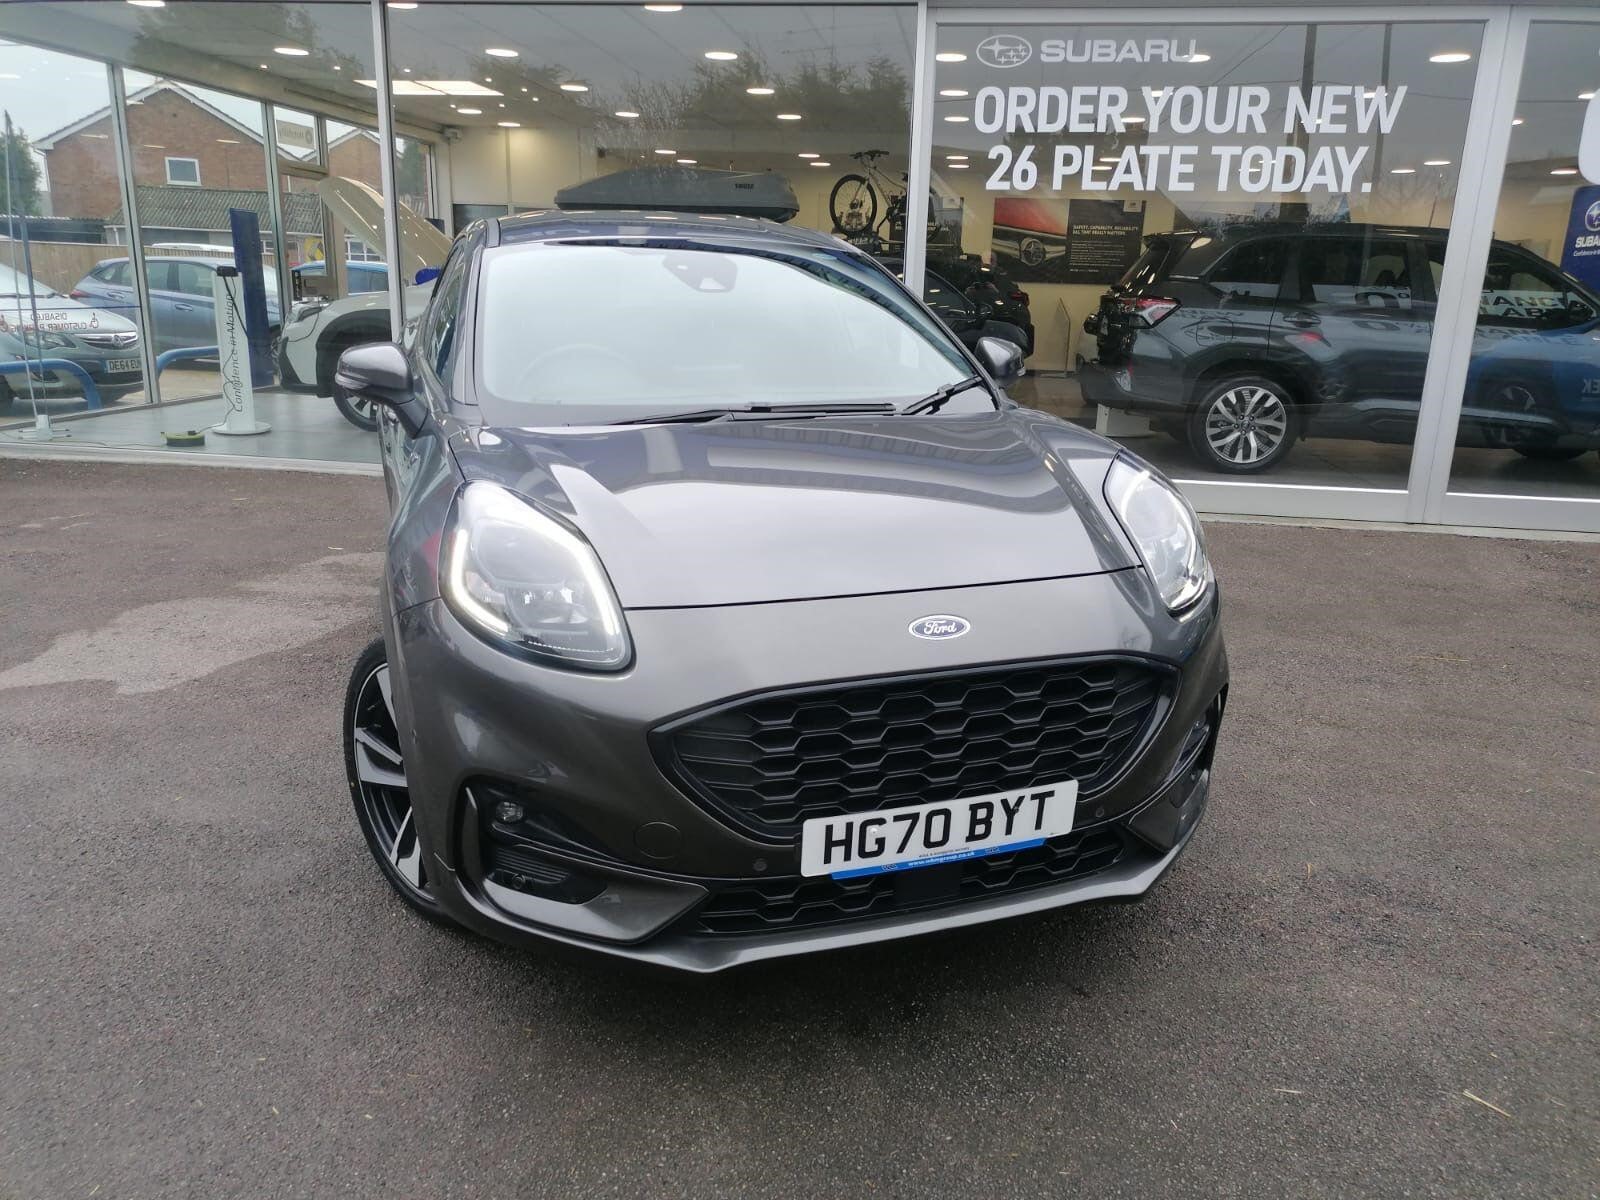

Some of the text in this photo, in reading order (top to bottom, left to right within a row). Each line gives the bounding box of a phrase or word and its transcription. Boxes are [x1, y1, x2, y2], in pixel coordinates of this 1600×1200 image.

[1040, 39, 1196, 63] SUBARU
[974, 86, 1408, 134] ORDER YOUR NEW
[985, 145, 1373, 193] 26 PLATE TODAY.
[225, 295, 235, 334] Motion
[923, 620, 957, 634] Ford
[823, 790, 1056, 865] HG70 BYT
